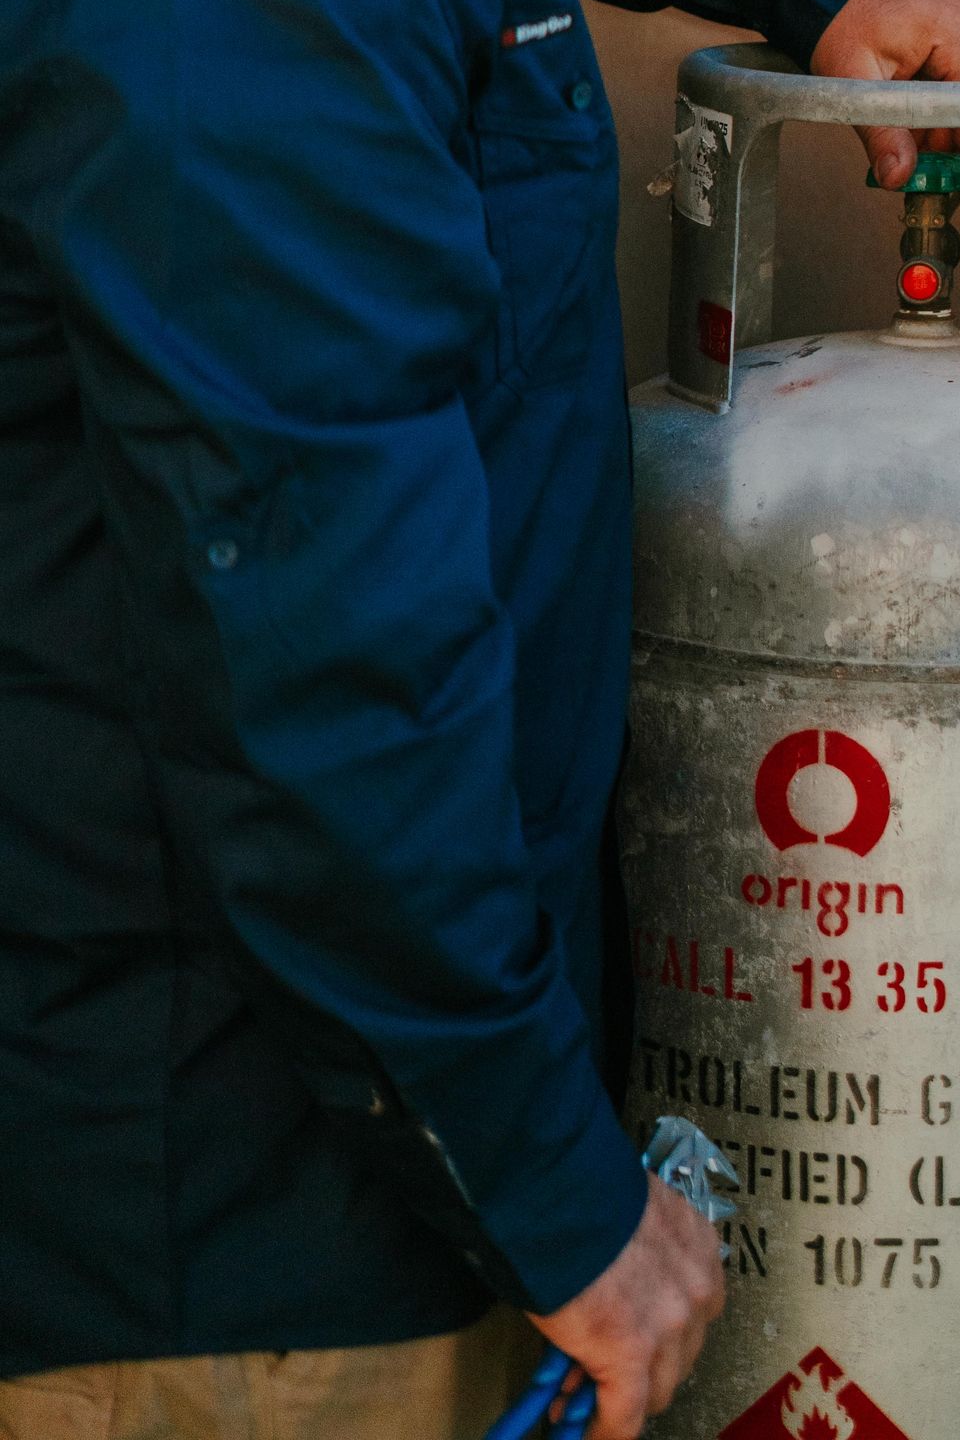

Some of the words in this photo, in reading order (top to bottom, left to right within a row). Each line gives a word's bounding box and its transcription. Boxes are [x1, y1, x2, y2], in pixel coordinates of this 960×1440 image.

[740, 872, 905, 938] origin
[791, 956, 853, 1012] 13
[876, 961, 948, 1014] 35
[803, 1233, 942, 1289] 1075
